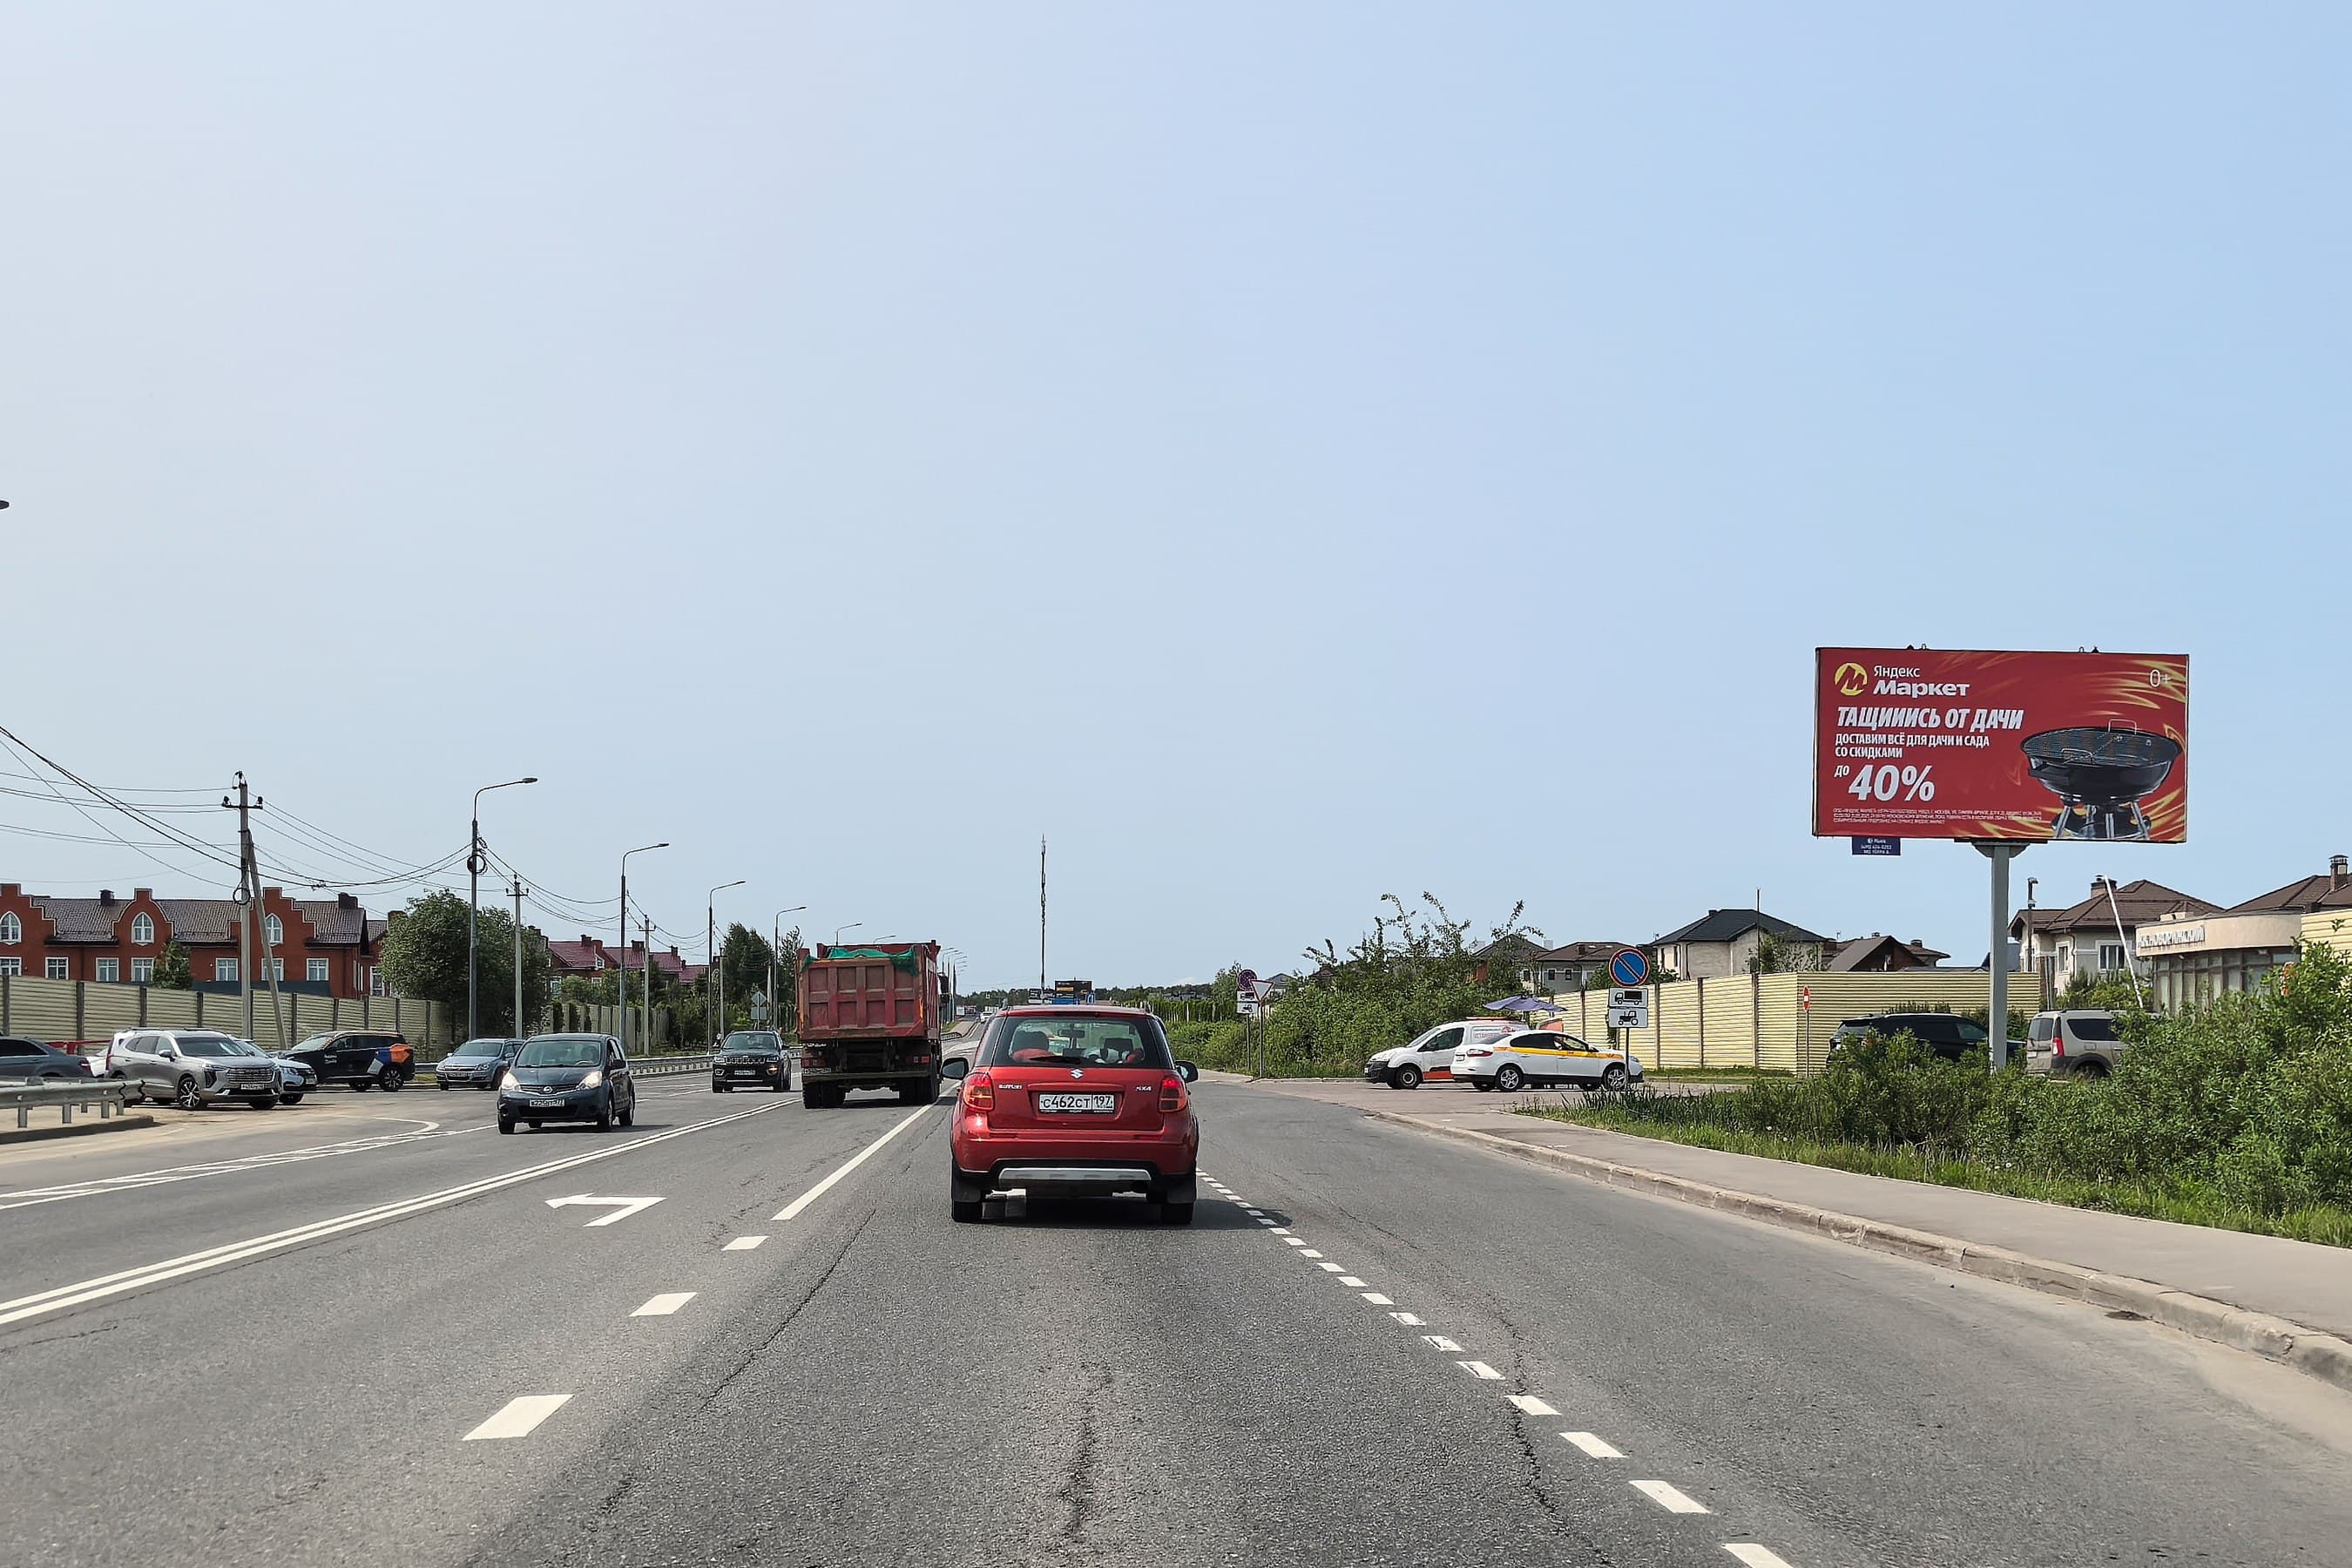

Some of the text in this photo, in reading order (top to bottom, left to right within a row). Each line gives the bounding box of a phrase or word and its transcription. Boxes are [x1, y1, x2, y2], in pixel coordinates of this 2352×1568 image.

[1874, 666, 1921, 678] Яндекс
[2150, 669, 2172, 686] 0+
[1873, 679, 1970, 698] Маркет
[1837, 706, 2024, 733] ТАЩИИИСЬ ОТ ДАЧИ
[1835, 732, 1990, 748] ДОСТАВИМ ВСЁ ДЛЯ ДАЧИ И САДА
[1835, 747, 1903, 760] СО СКИДКАМИ
[1848, 765, 1935, 801] 40%
